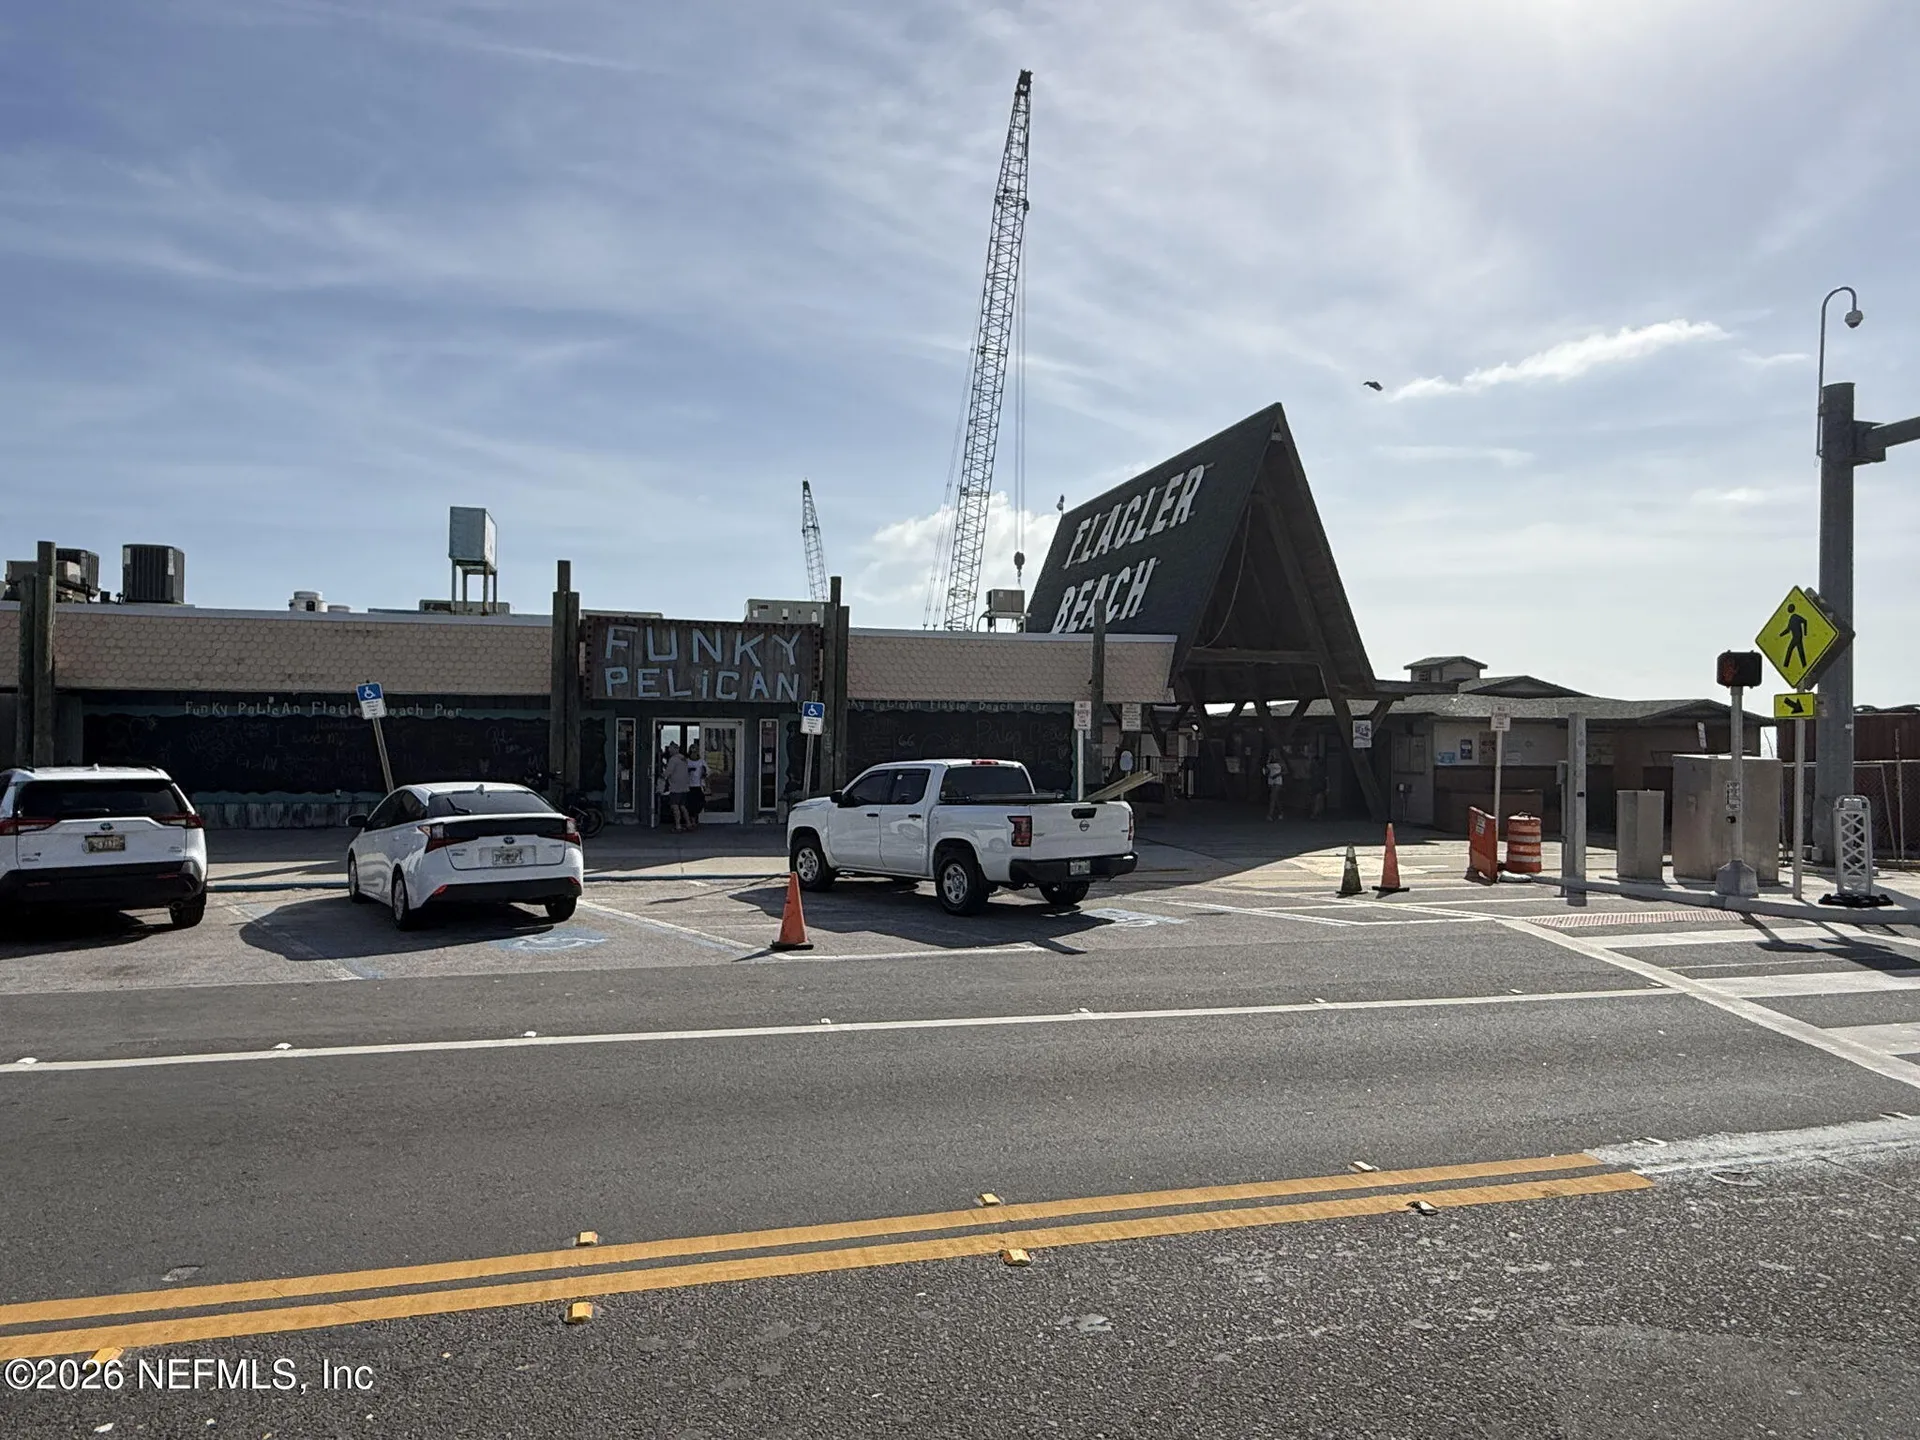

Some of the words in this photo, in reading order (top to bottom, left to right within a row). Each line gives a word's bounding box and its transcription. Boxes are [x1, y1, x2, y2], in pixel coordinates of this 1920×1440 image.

[1062, 464, 1205, 570] FLAGLER
[1050, 557, 1157, 634] BEACH
[604, 624, 802, 668] FUNKY
